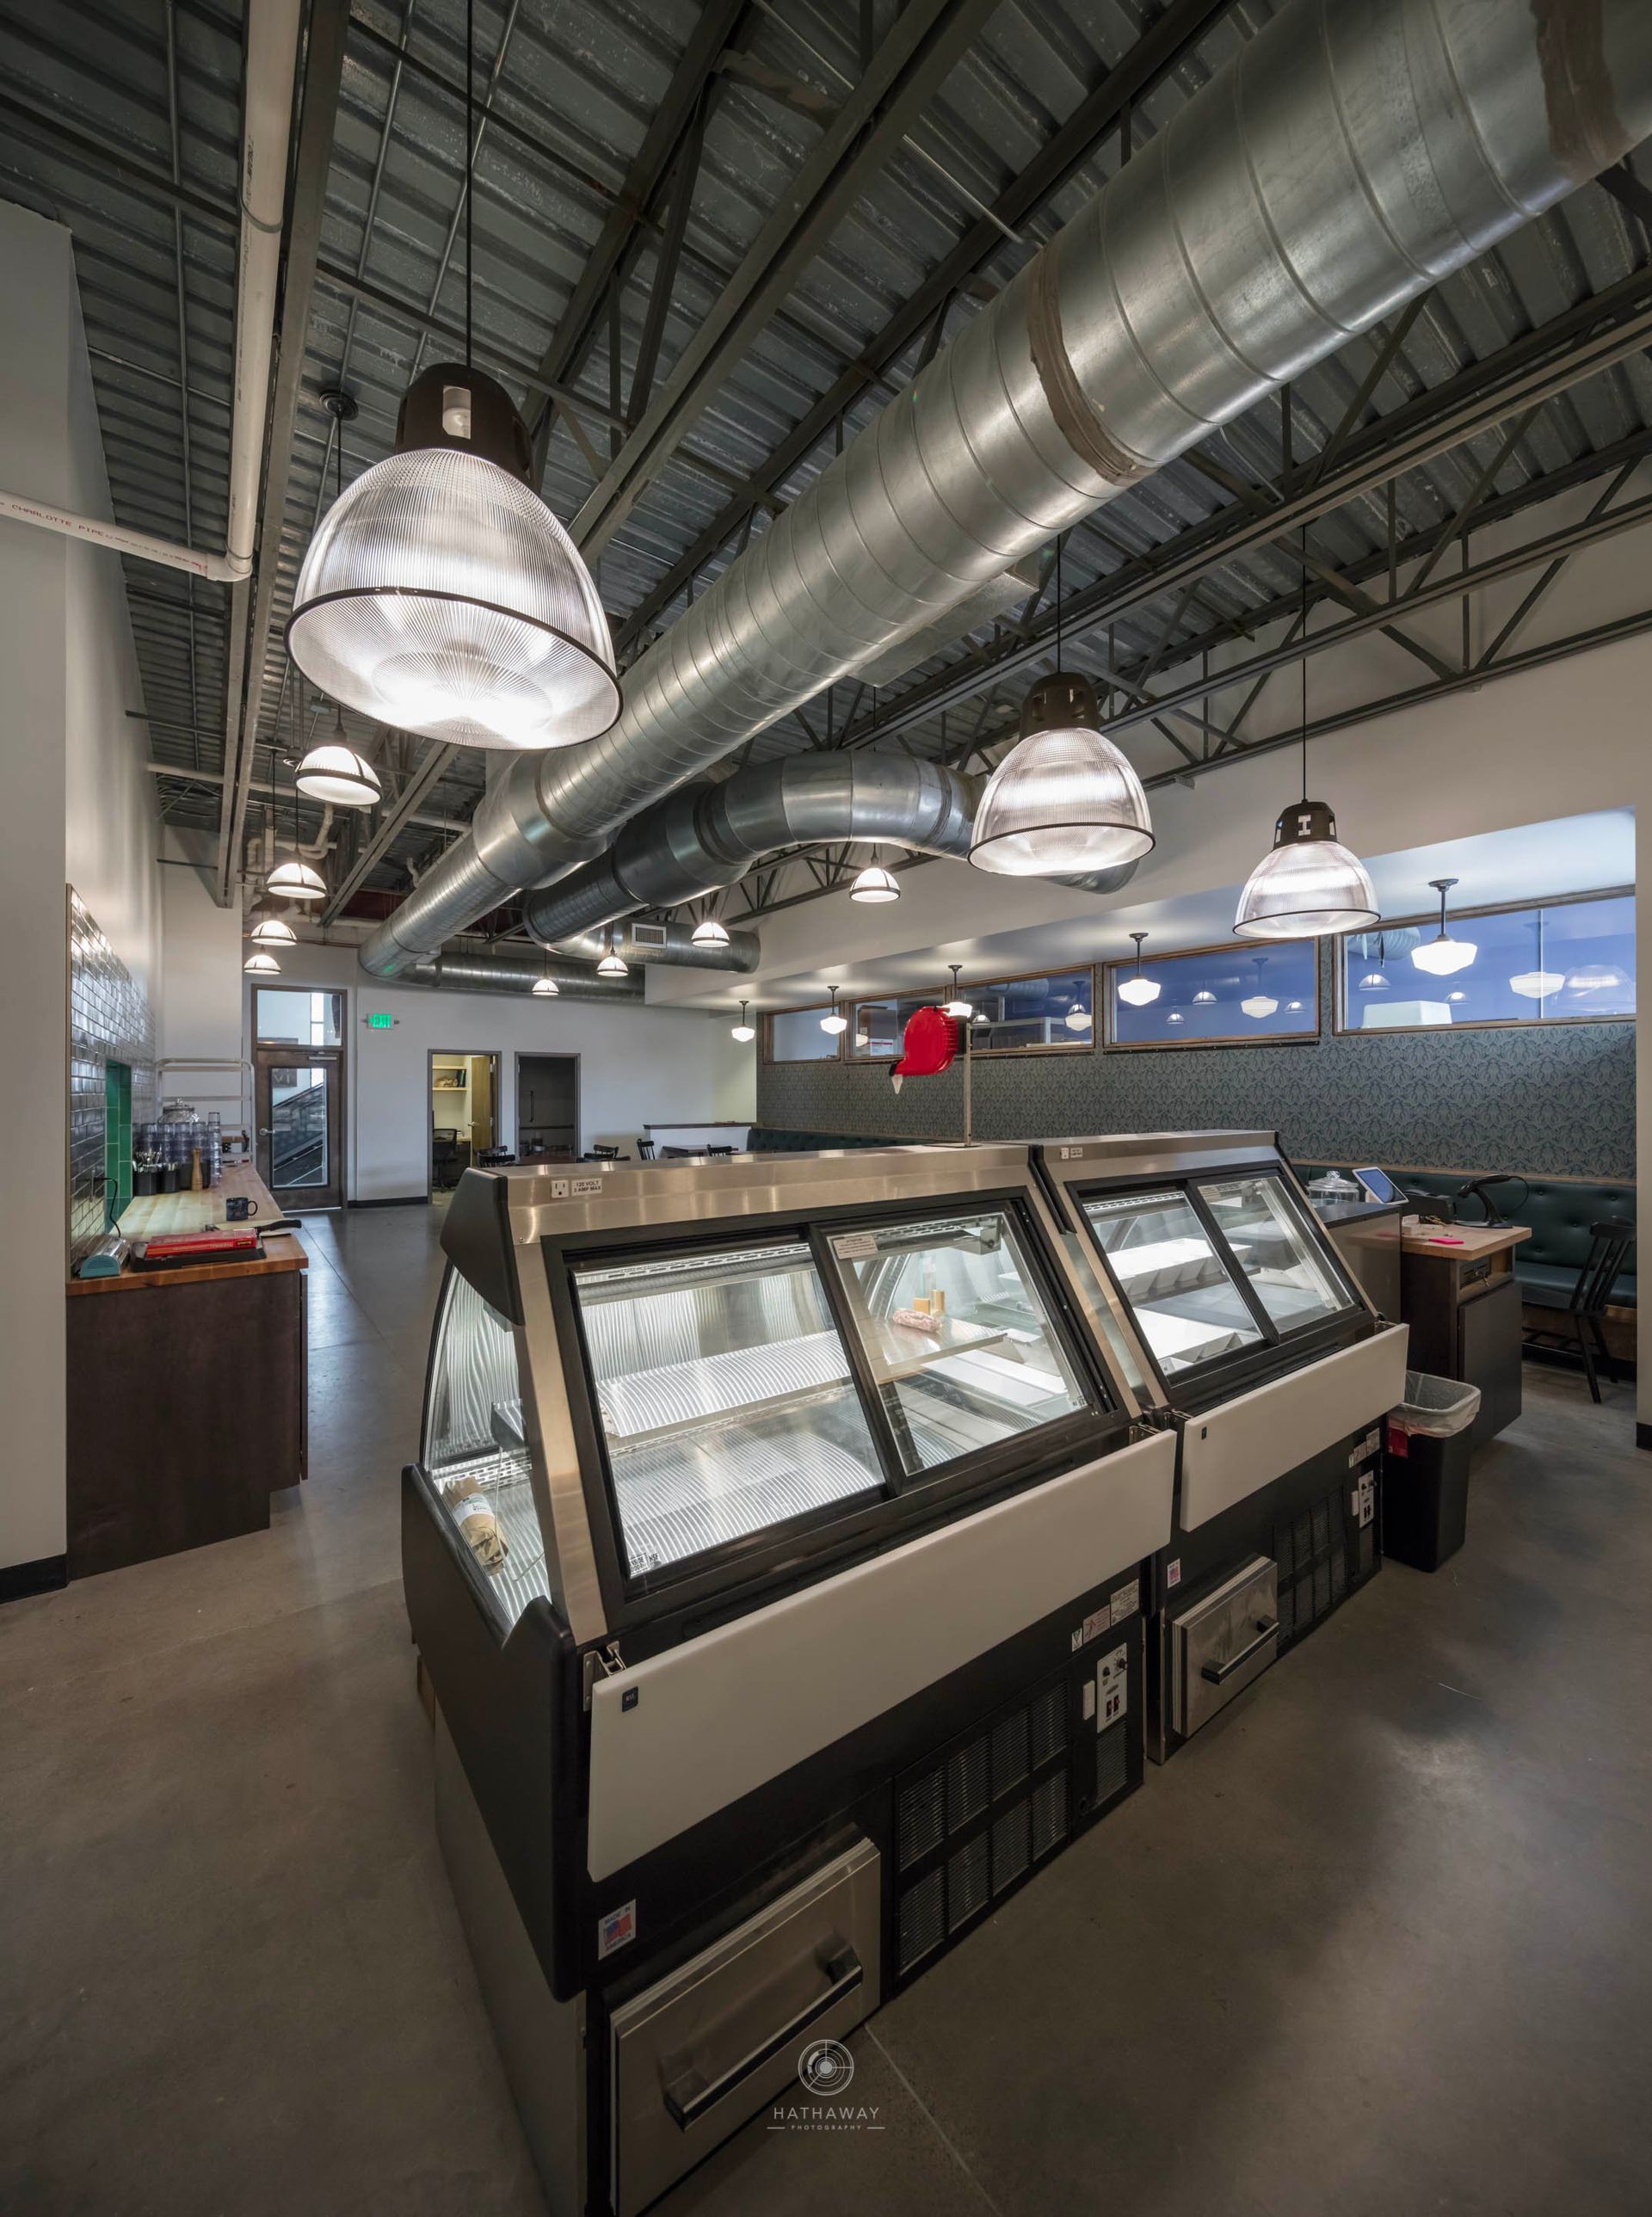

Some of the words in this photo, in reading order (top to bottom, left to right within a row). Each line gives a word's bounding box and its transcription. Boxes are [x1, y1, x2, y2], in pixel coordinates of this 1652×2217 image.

[11, 503, 71, 527] CHARLOTTE
[77, 524, 104, 536] PIPE
[373, 1013, 392, 1028] EXIT
